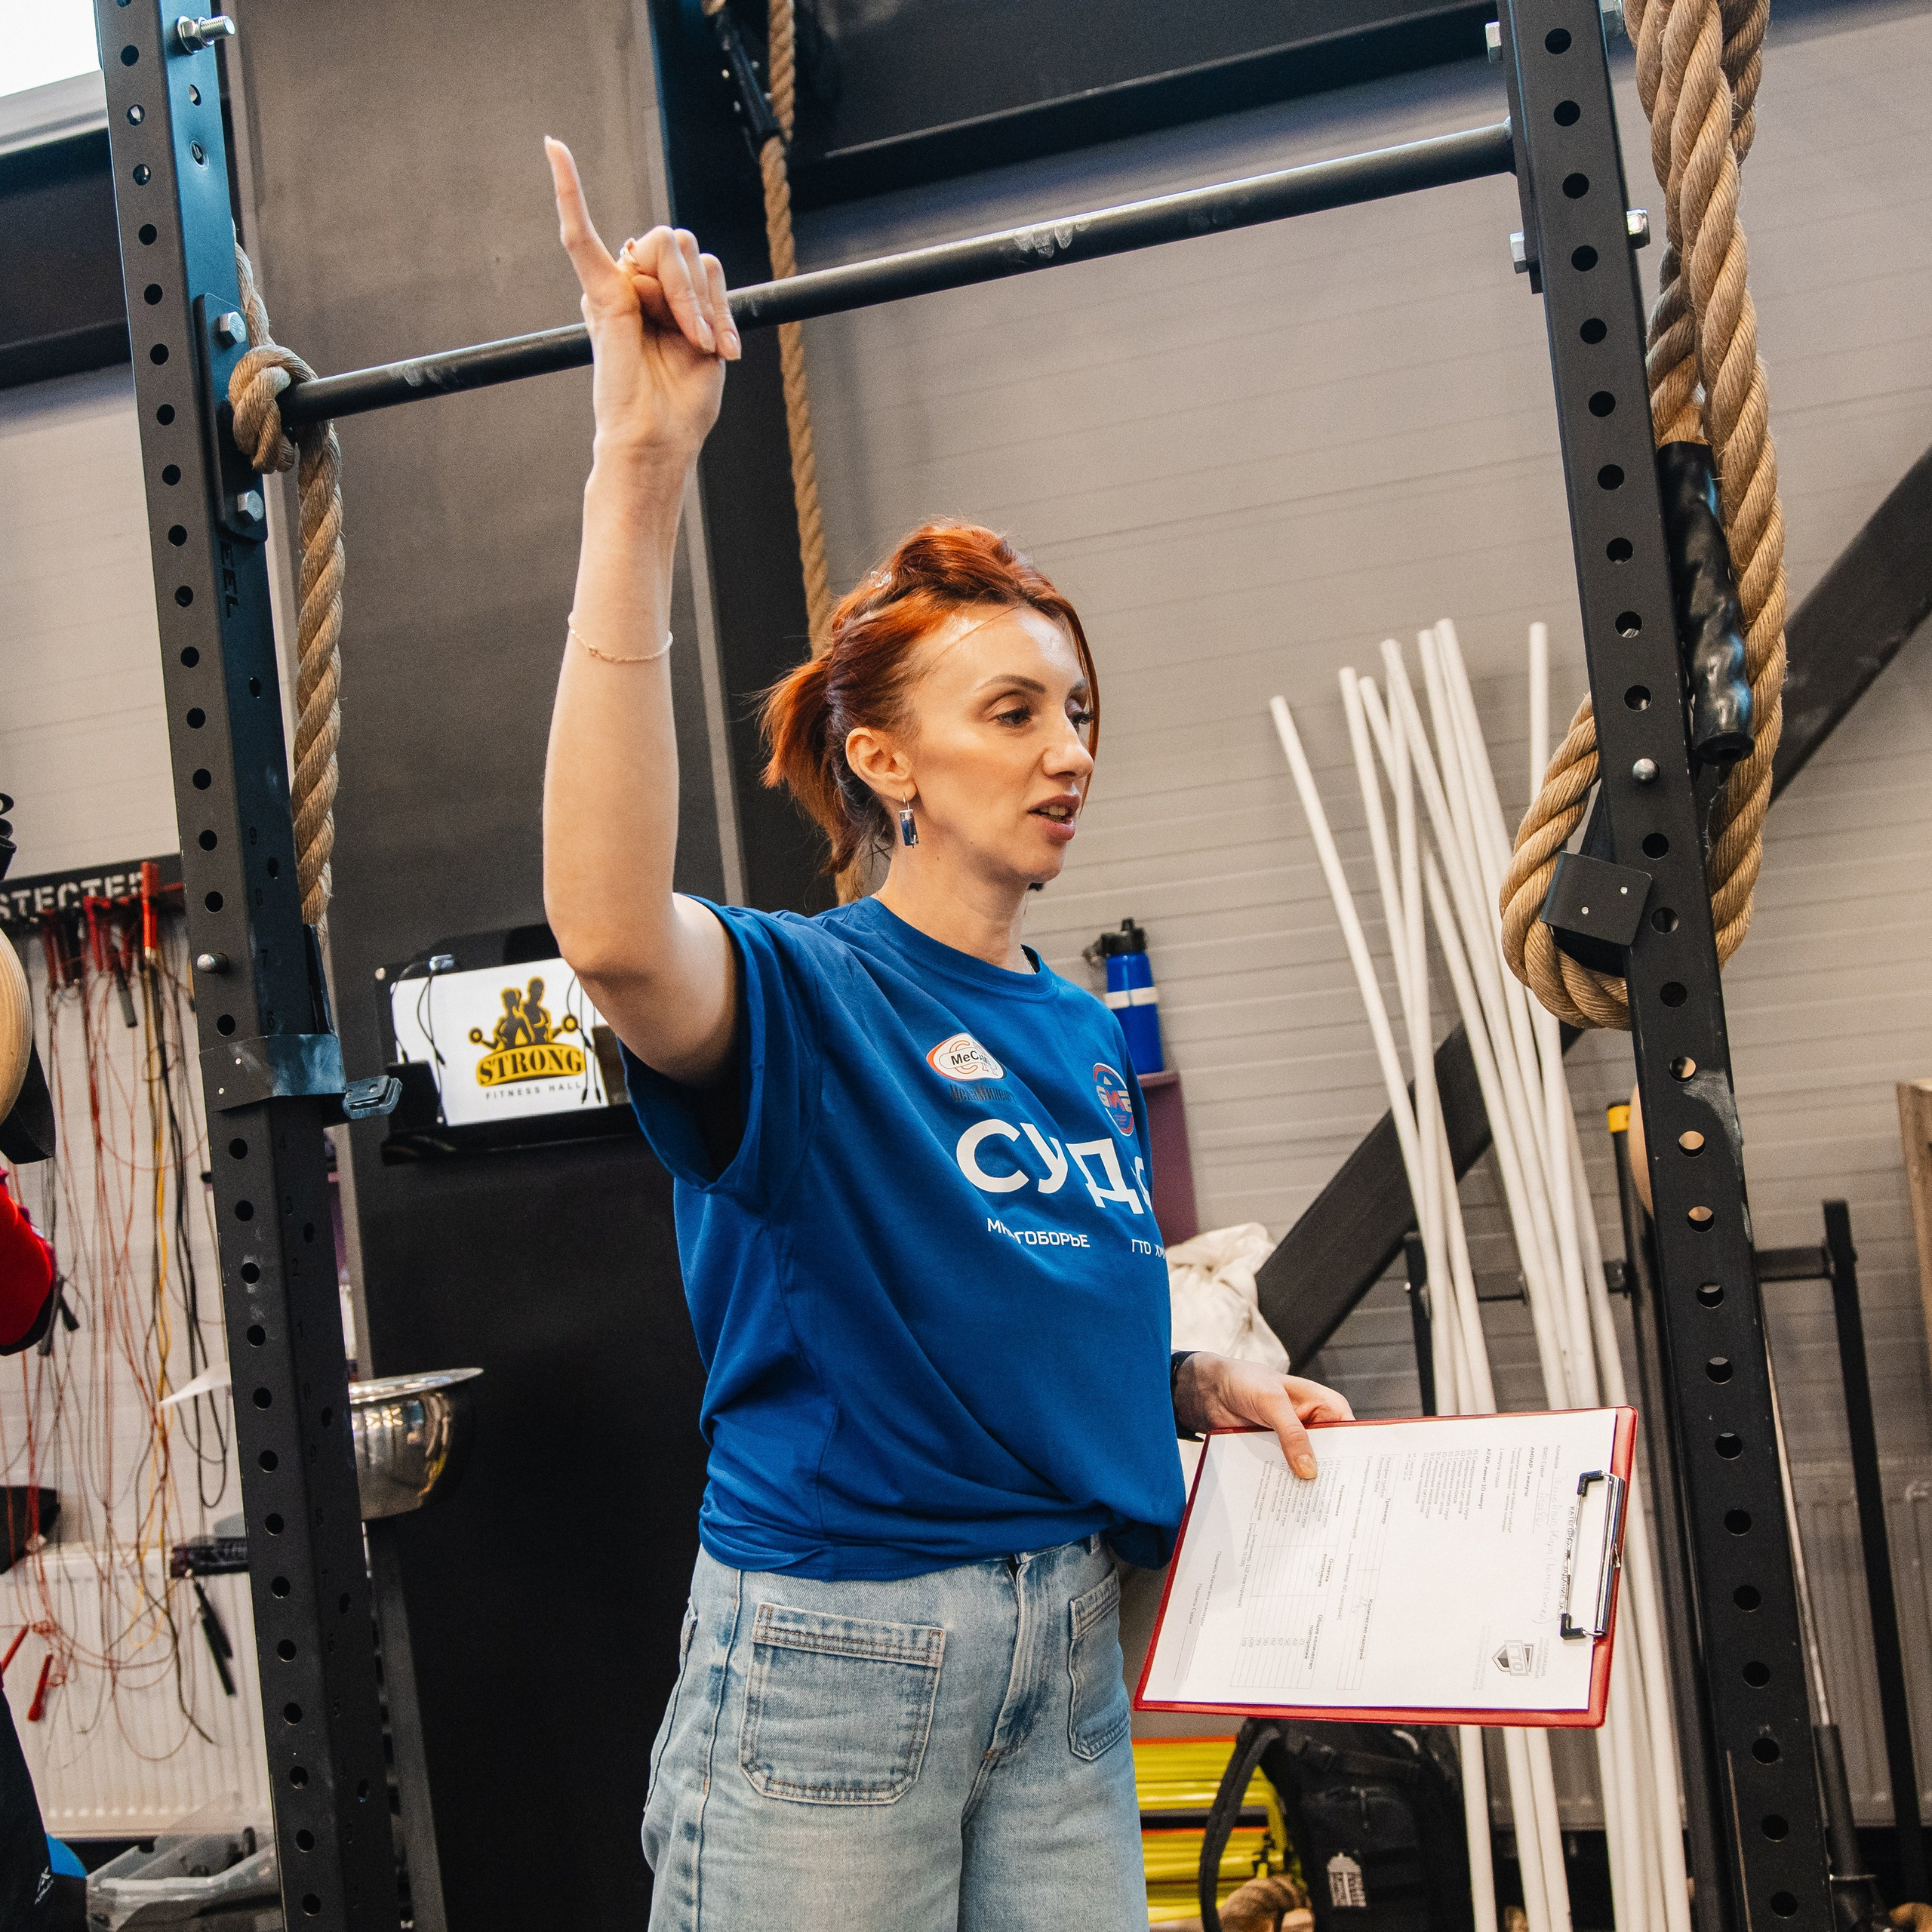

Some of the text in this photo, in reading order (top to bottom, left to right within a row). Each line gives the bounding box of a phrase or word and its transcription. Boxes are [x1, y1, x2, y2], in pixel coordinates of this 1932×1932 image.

[480, 1048, 582, 1084] STRONG
[486, 1081, 581, 1100] FITNESS HALL
[956, 1118, 1153, 1214] СУД
[987, 1217, 1091, 1248] МНГОБОРЬЕ
[1131, 1238, 1152, 1255] ГТО
[1334, 1484, 1346, 1517] Упражнение
[1476, 1492, 1484, 1509] минут
[1480, 1483, 1487, 1491] 10
[1380, 1497, 1392, 1524] Тренажер
[1211, 1550, 1223, 1574] Подпись
[1316, 1552, 1328, 1587] выполнения
[1324, 1558, 1334, 1582] Отметка
[1191, 1583, 1203, 1606] Подпись
[1204, 1574, 1217, 1600] Капитана
[1361, 1598, 1374, 1634] Количество
[1302, 1624, 1315, 1660] повторений
[1306, 1614, 1324, 1669] Общее количество
[1356, 1634, 1368, 1660] калорий
[1509, 1644, 1524, 1672] ГТО
